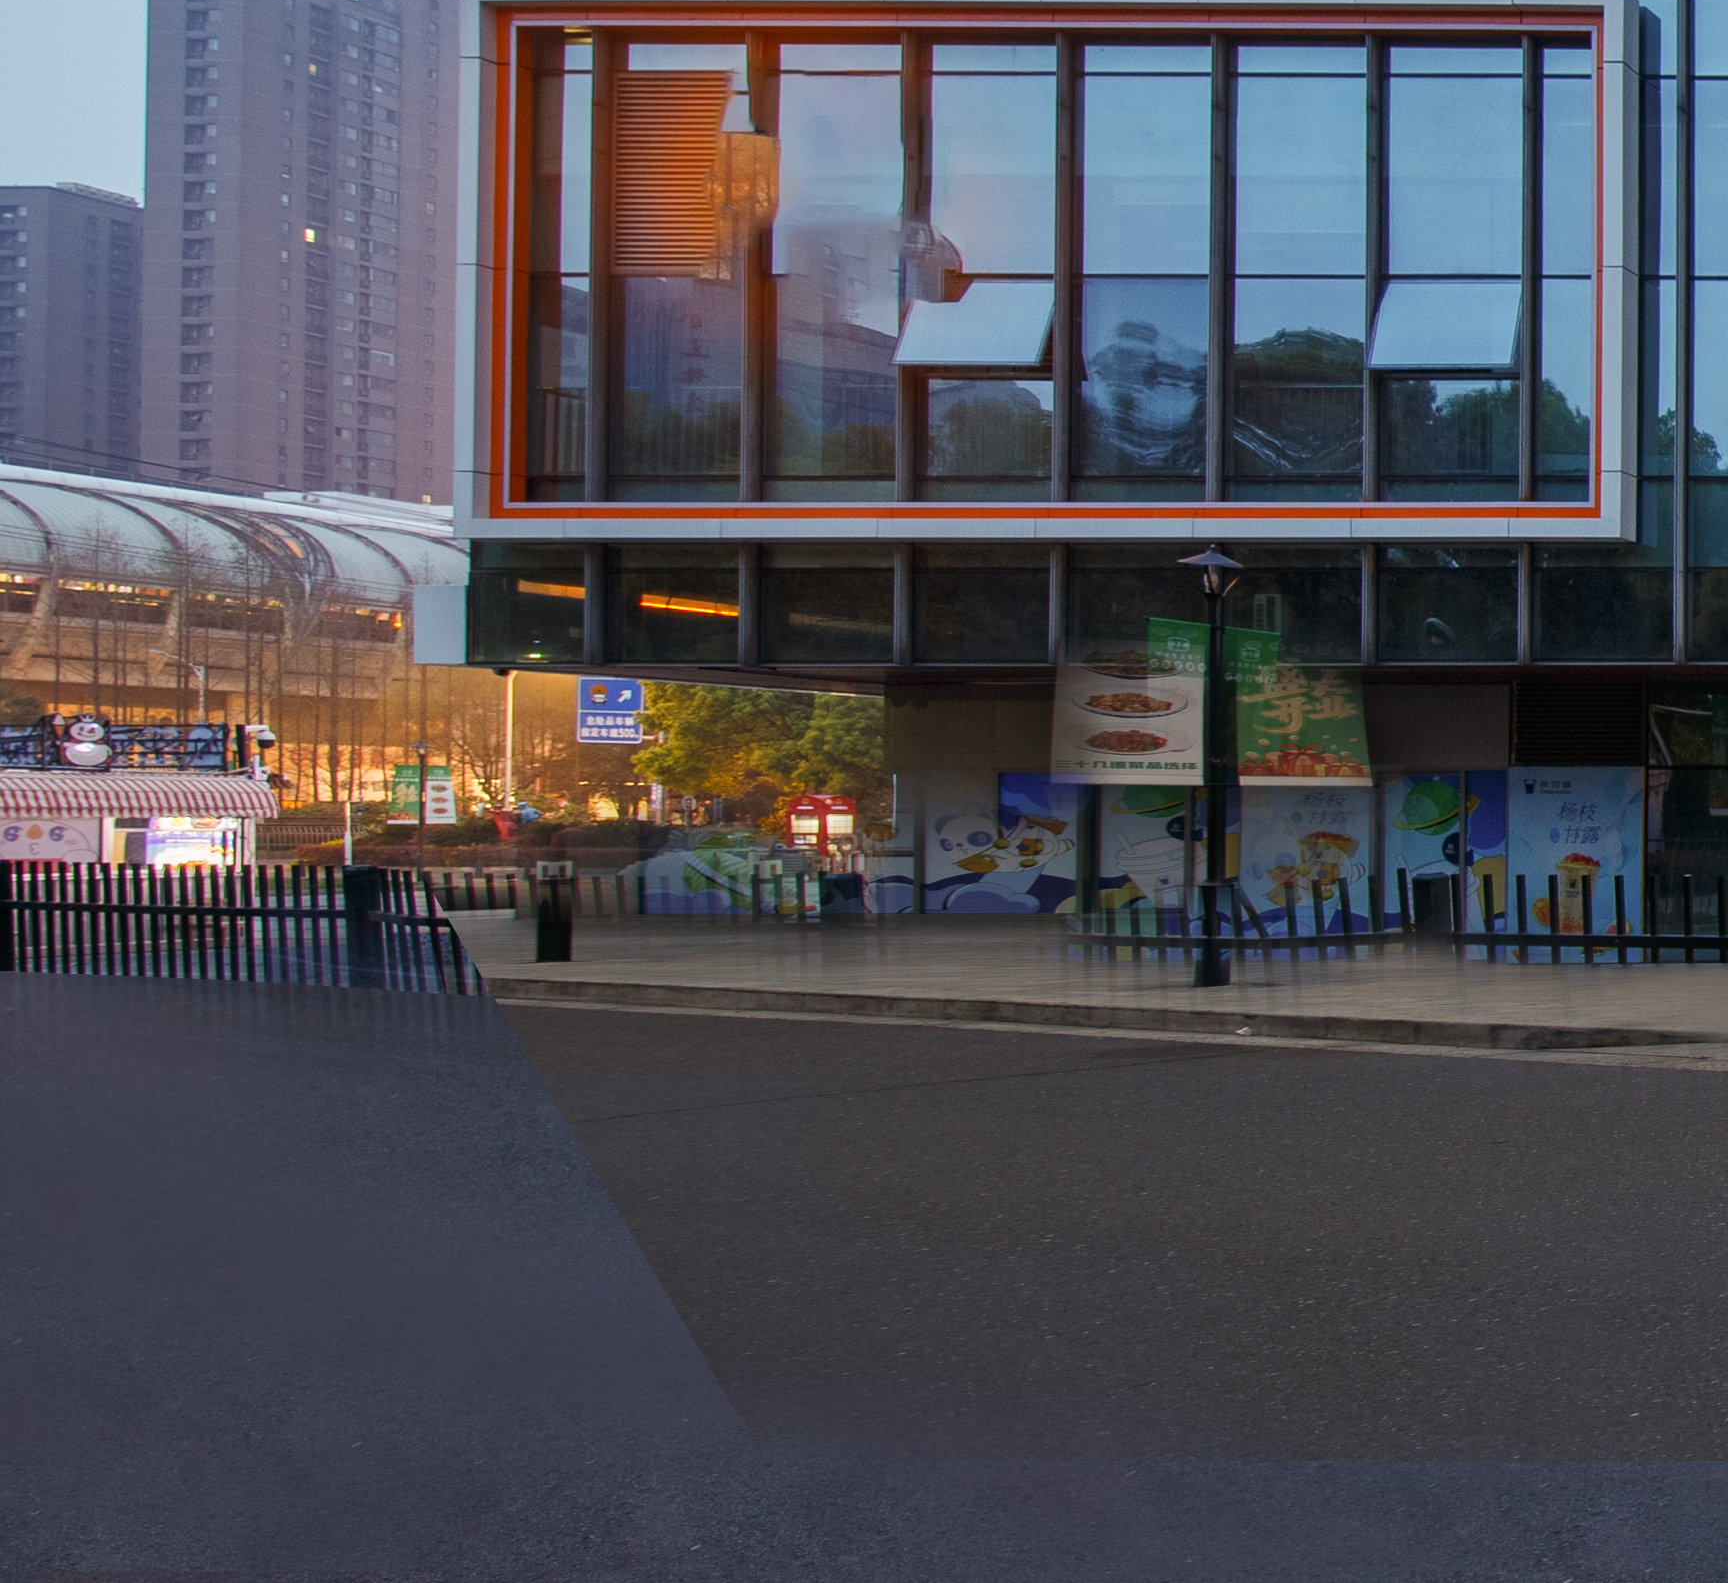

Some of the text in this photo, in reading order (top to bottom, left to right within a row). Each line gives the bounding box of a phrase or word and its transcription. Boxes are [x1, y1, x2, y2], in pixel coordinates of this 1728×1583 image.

[1054, 759, 1199, 771] 三十几道菜品选择
[1558, 802, 1598, 822] 杨枝
[1564, 826, 1601, 845] 甘露
